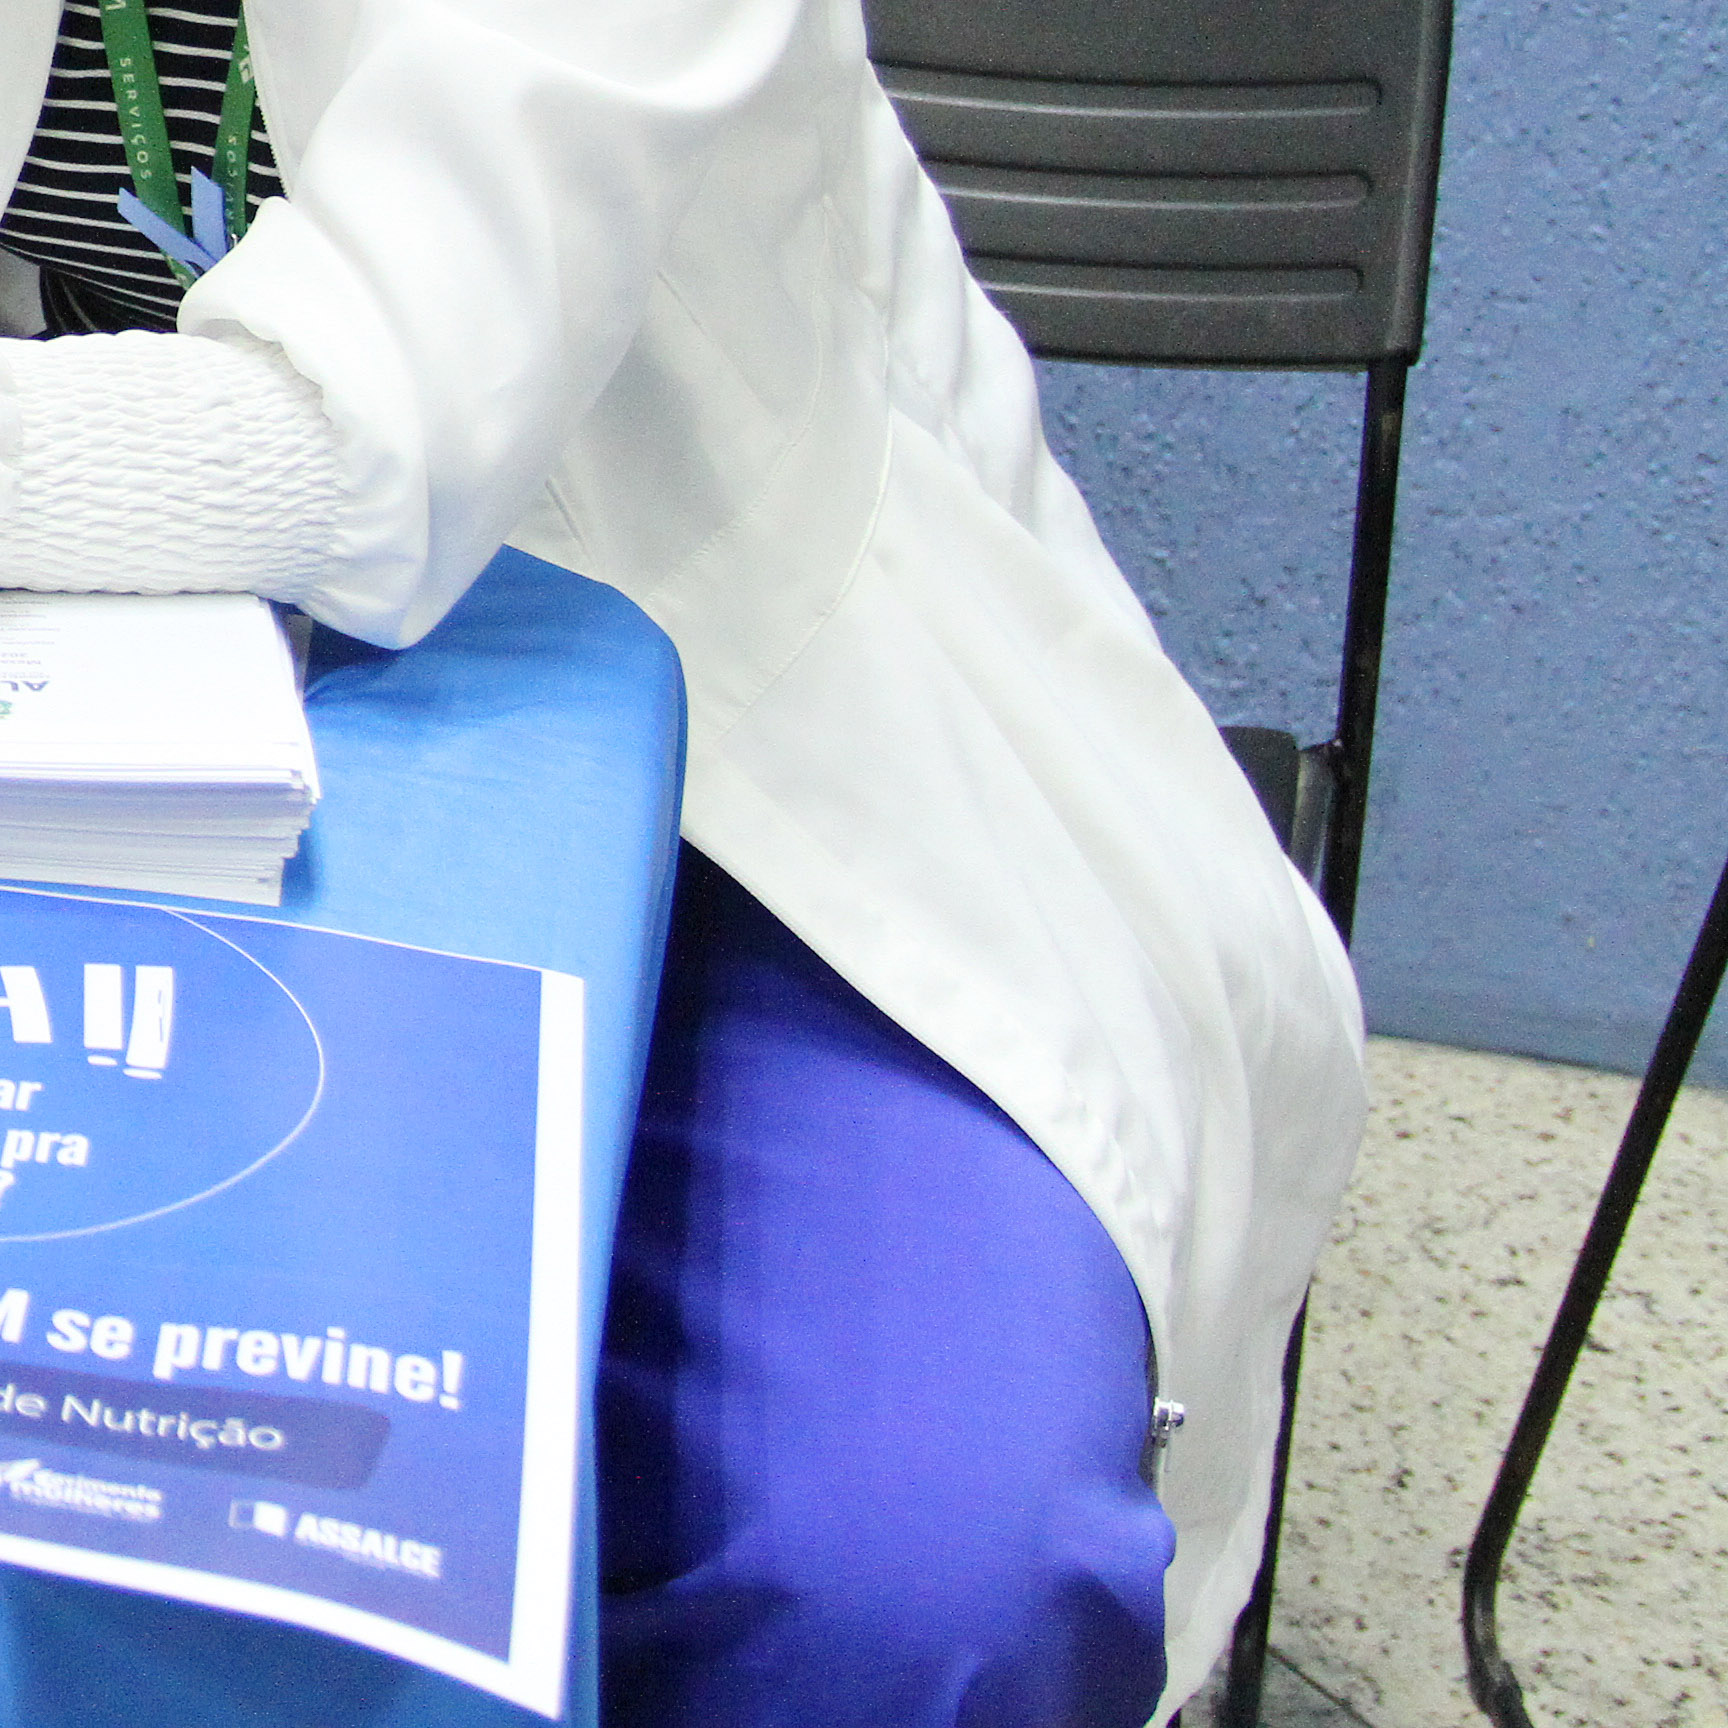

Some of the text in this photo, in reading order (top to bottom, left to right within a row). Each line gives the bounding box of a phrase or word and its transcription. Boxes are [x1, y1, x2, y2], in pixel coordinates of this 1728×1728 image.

[120, 56, 152, 182] SERVIÇOS
[0, 1127, 91, 1169] pra
[44, 1306, 135, 1360] se
[152, 1320, 465, 1412] previne!
[60, 1393, 285, 1450] Nutrição
